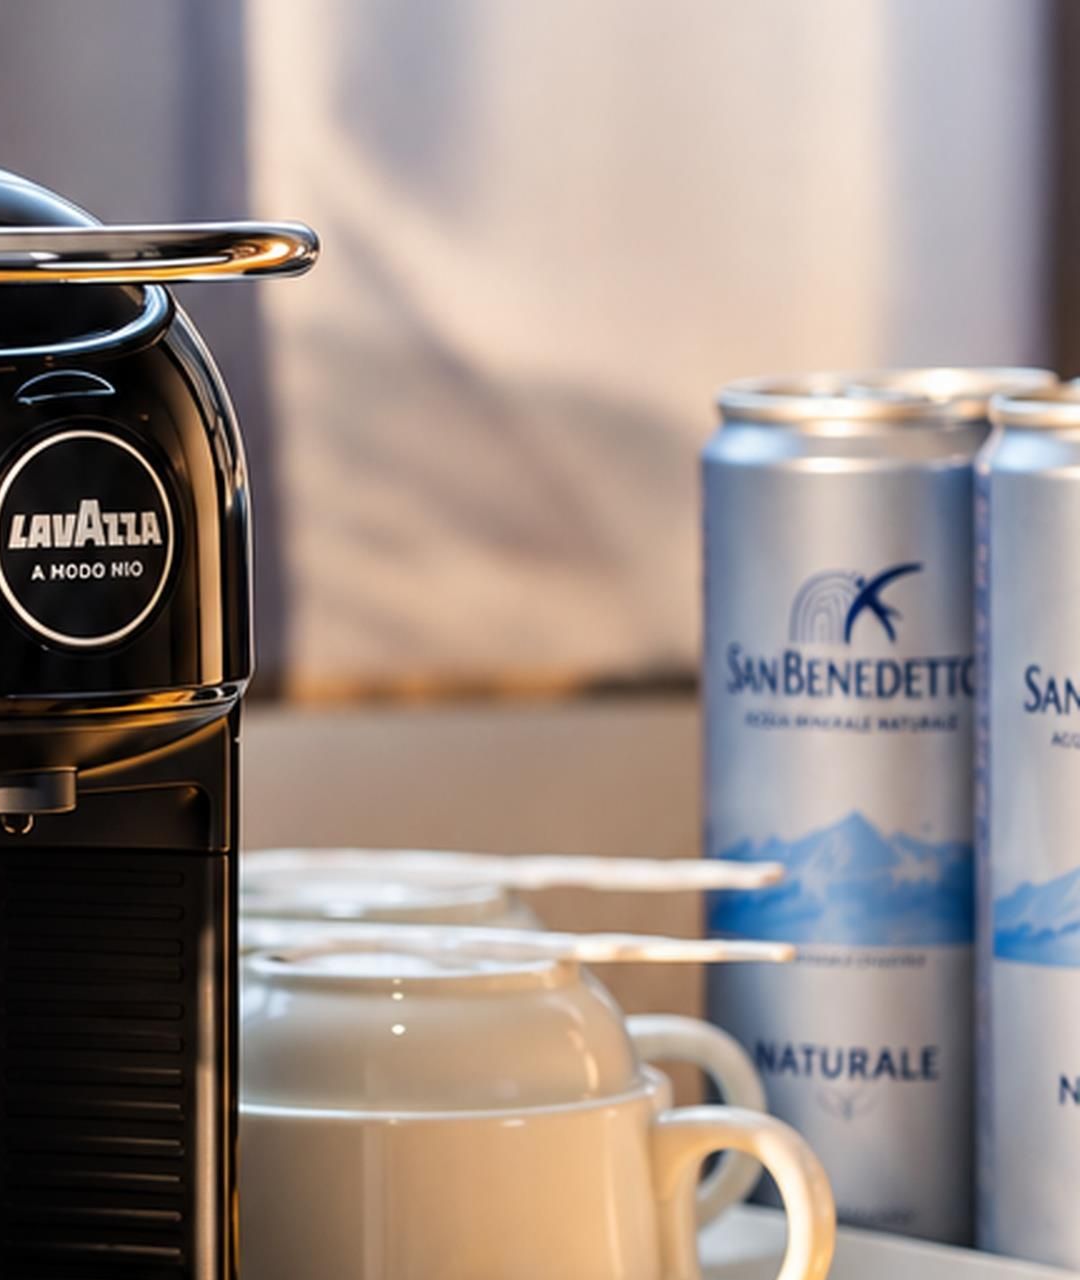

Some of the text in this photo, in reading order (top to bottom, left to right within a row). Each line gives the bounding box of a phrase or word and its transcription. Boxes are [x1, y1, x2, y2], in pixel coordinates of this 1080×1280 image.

[8, 499, 162, 549] LAVAZZA
[31, 564, 46, 581] A
[754, 1040, 939, 1081] NATURALE
